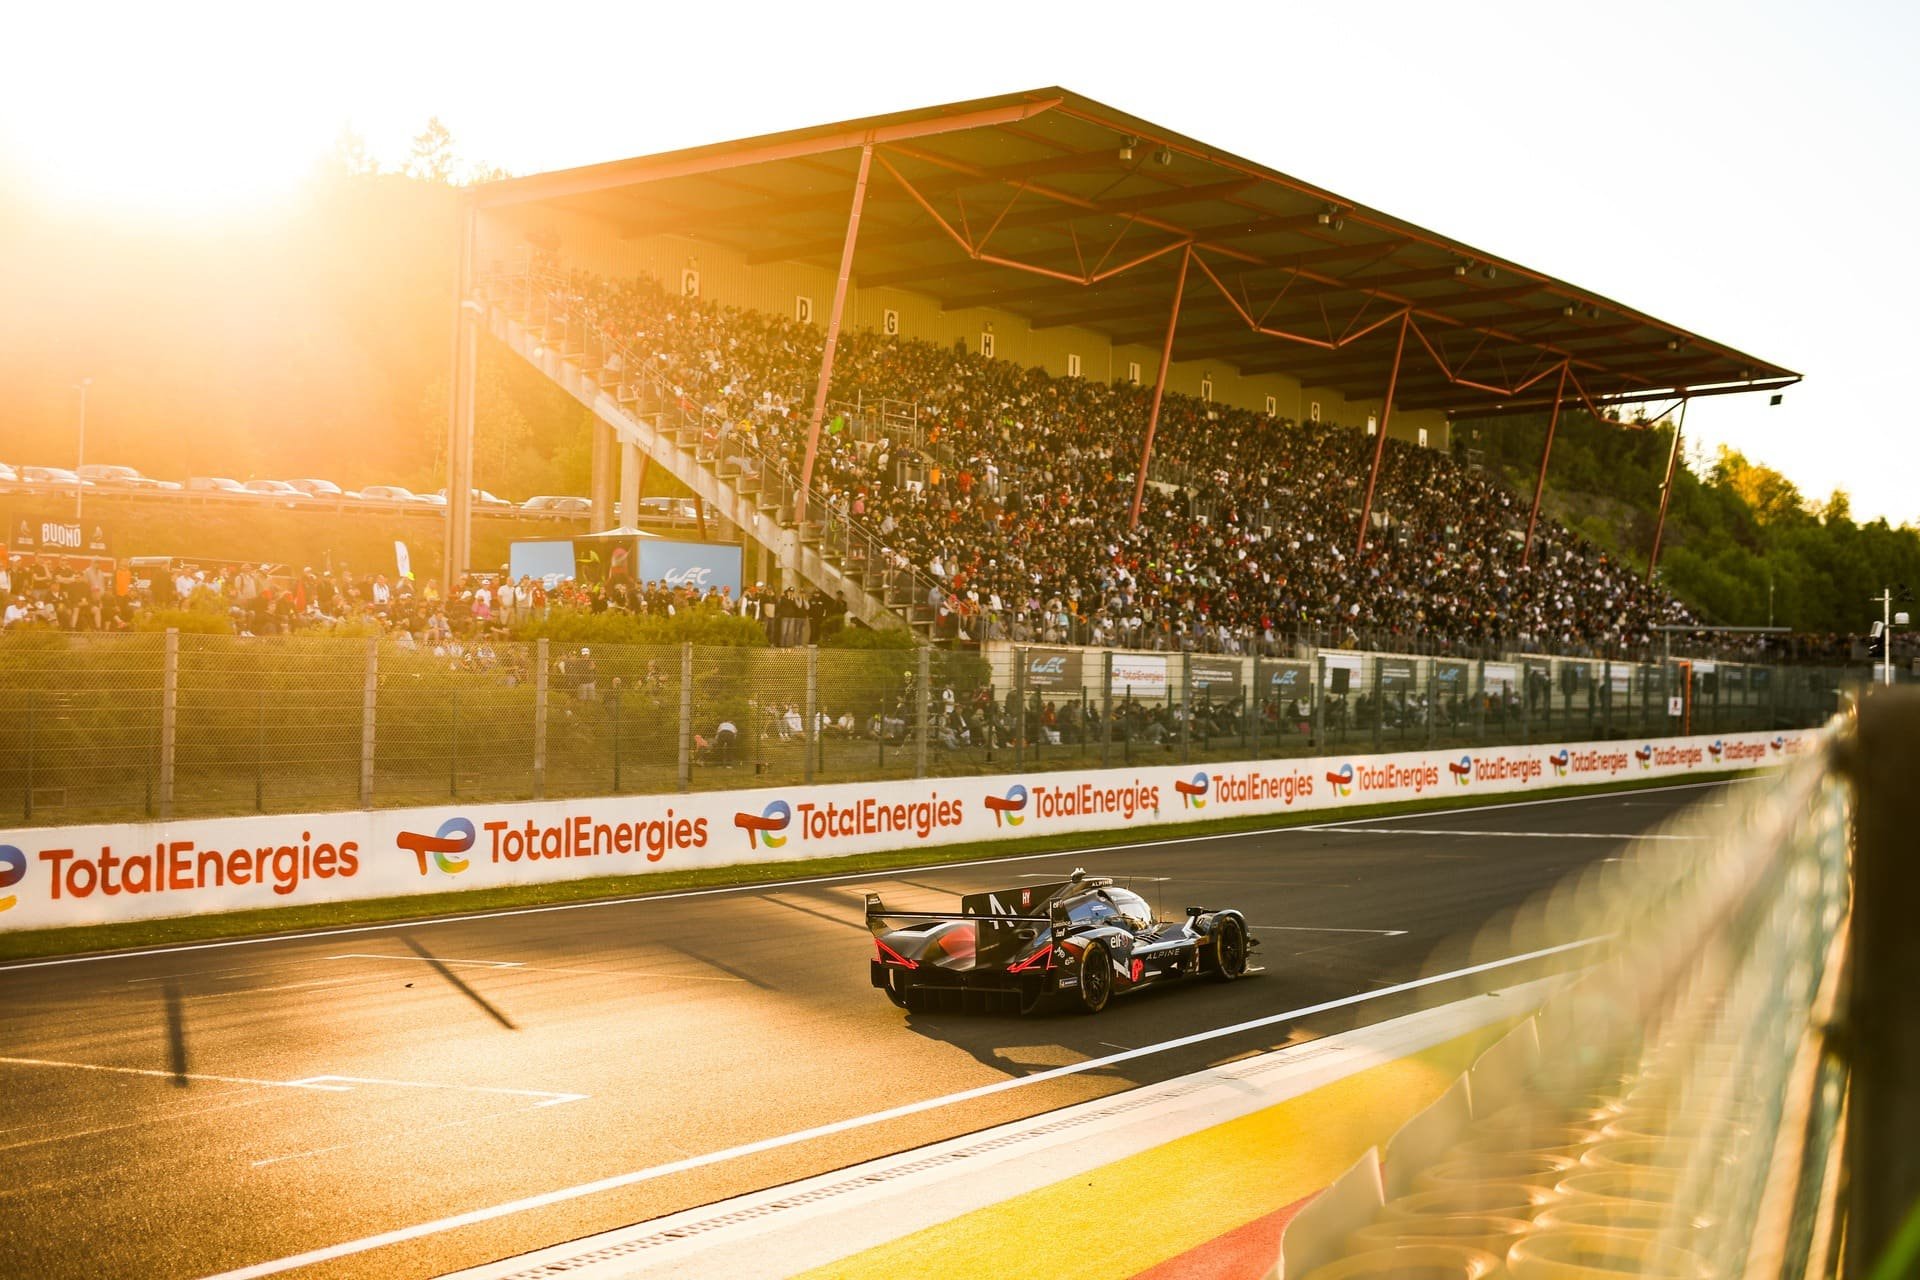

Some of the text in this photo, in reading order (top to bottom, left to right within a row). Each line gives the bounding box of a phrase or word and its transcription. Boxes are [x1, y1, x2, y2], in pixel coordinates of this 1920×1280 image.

[800, 299, 808, 321] D
[887, 312, 896, 333] G
[1031, 656, 1067, 673] WEC
[1474, 753, 1541, 783] TotalEnergies
[1570, 748, 1628, 775] TotalEnergies
[1212, 769, 1313, 805] TotalEnergies
[1357, 761, 1439, 793] TotalEnergies
[1033, 779, 1160, 820] TotalEnergies
[797, 792, 963, 839] TotalEnergies
[484, 808, 708, 863] TotalEnergies
[38, 831, 360, 900] TotalEnergies
[1022, 891, 1030, 905] HY
[1145, 948, 1181, 961] ALPINE
